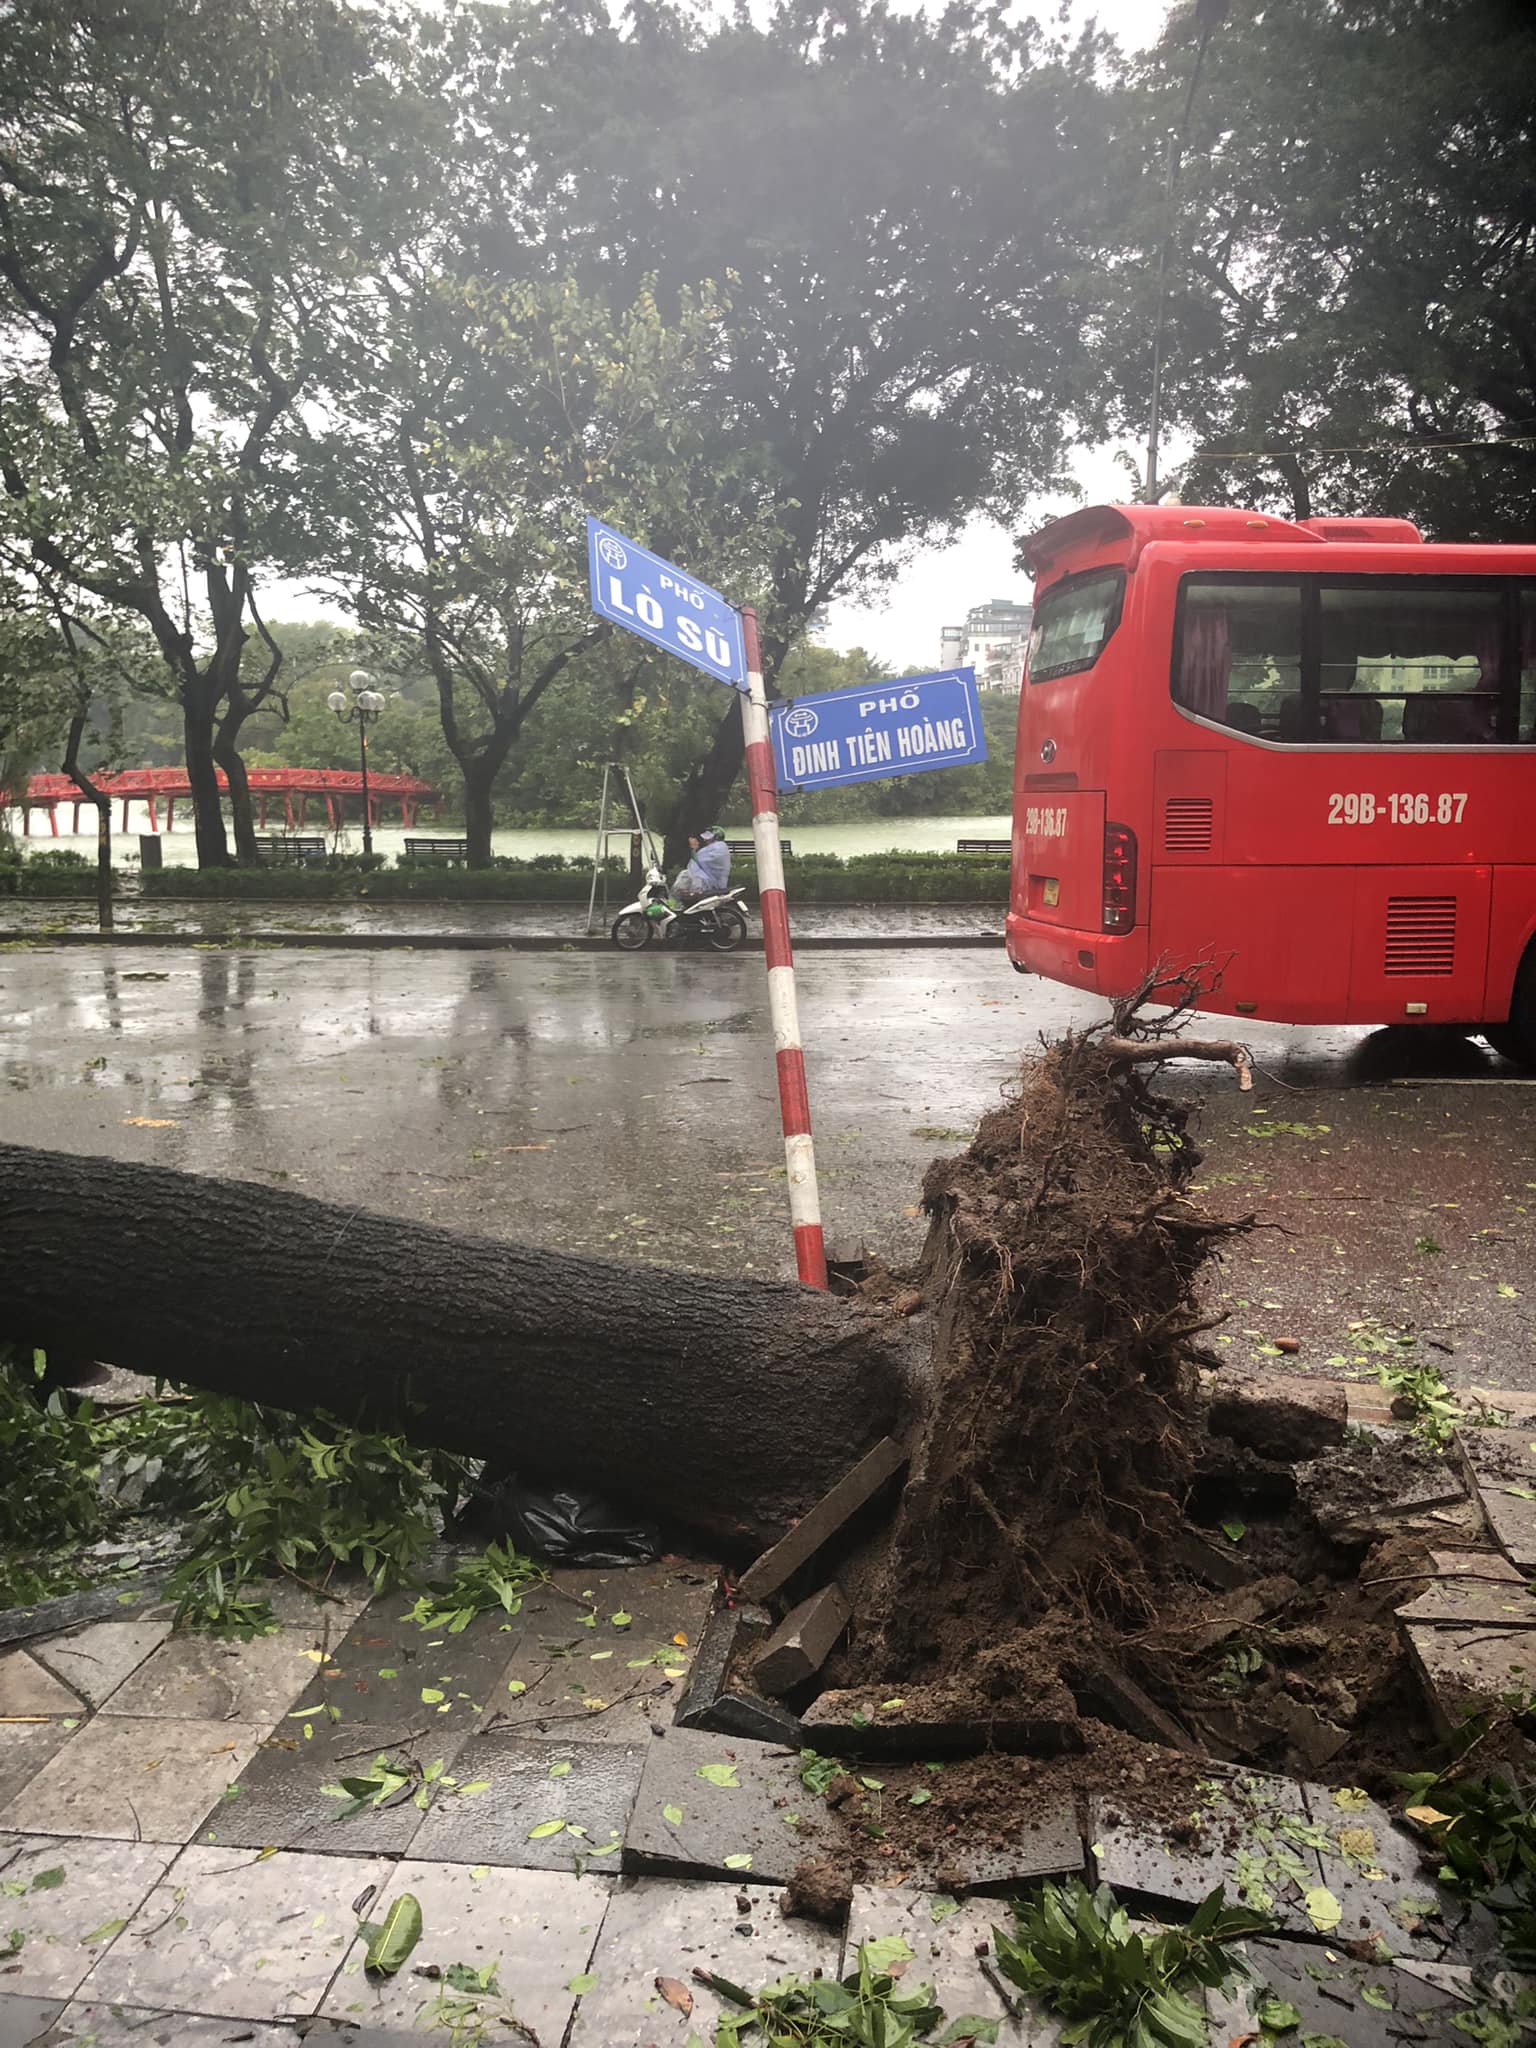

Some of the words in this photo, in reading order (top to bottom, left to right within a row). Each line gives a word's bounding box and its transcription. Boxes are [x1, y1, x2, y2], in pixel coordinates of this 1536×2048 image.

[660, 574, 704, 610] PHỐ
[610, 576, 664, 629] LÒ
[676, 616, 731, 668] SŨ
[859, 686, 920, 717] PHỐ
[792, 740, 840, 776] ĐINH
[846, 727, 892, 766] TIÊN
[897, 716, 966, 758] HOÀNG
[1328, 793, 1468, 824] 29B-136.87
